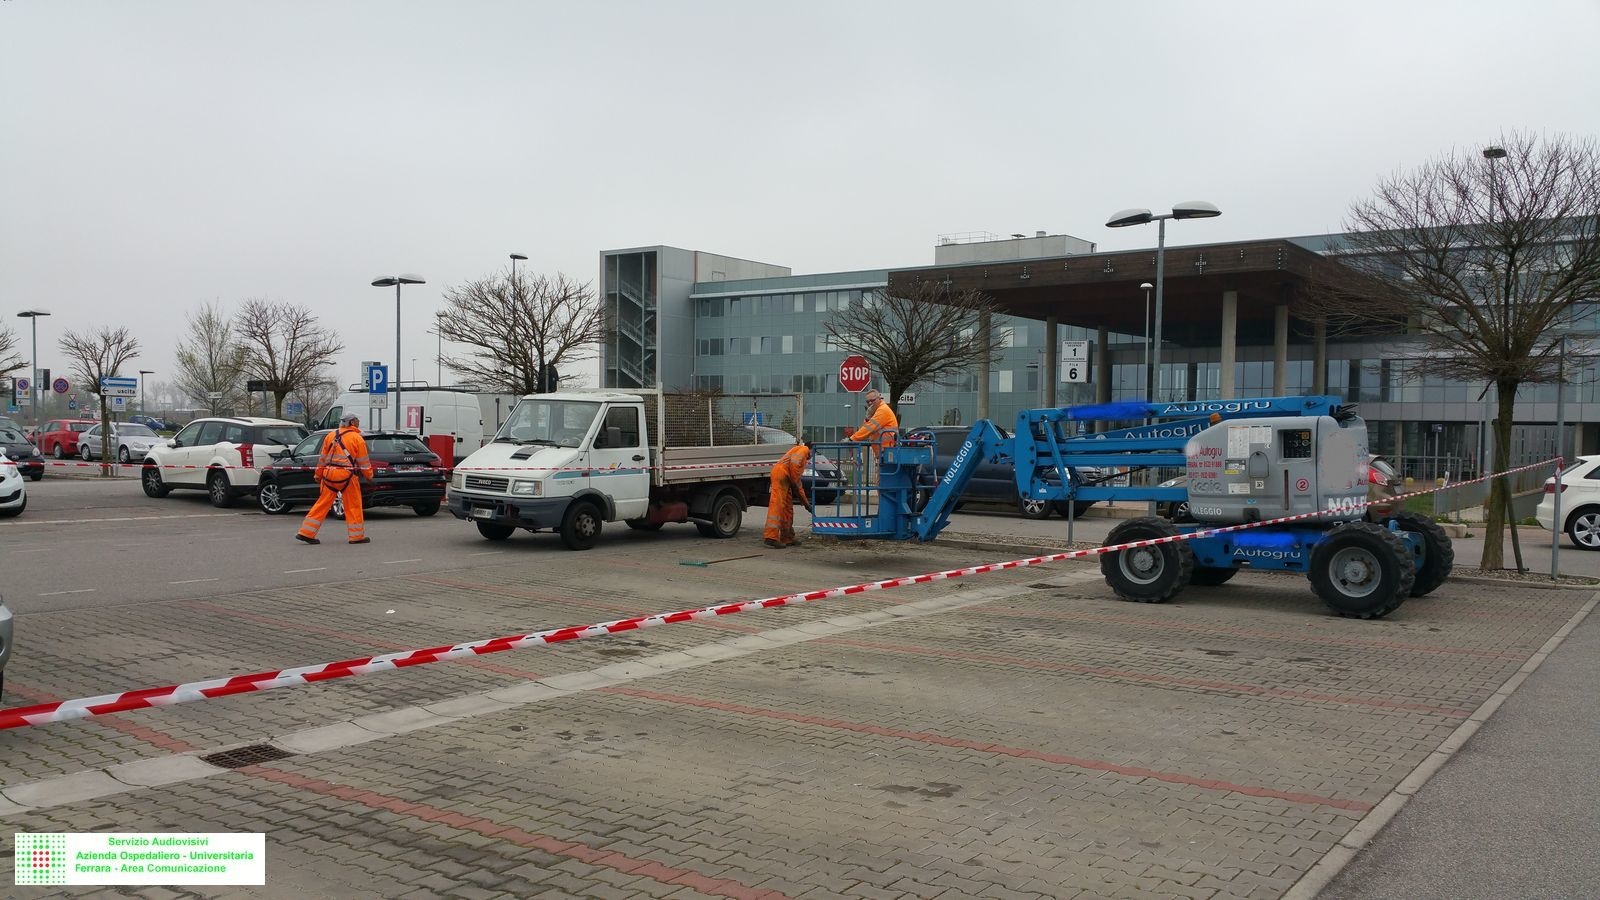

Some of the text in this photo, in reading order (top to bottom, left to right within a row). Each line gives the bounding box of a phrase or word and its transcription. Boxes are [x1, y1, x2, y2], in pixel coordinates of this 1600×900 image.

[1072, 348, 1077, 356] 1
[372, 370, 383, 390] P
[842, 366, 868, 380] STOP
[1069, 368, 1078, 380] 6
[1164, 400, 1272, 414] Autogru
[1125, 422, 1210, 439] Autogru
[944, 440, 972, 484] NOLEGGIO
[1234, 548, 1300, 560] Autogru
